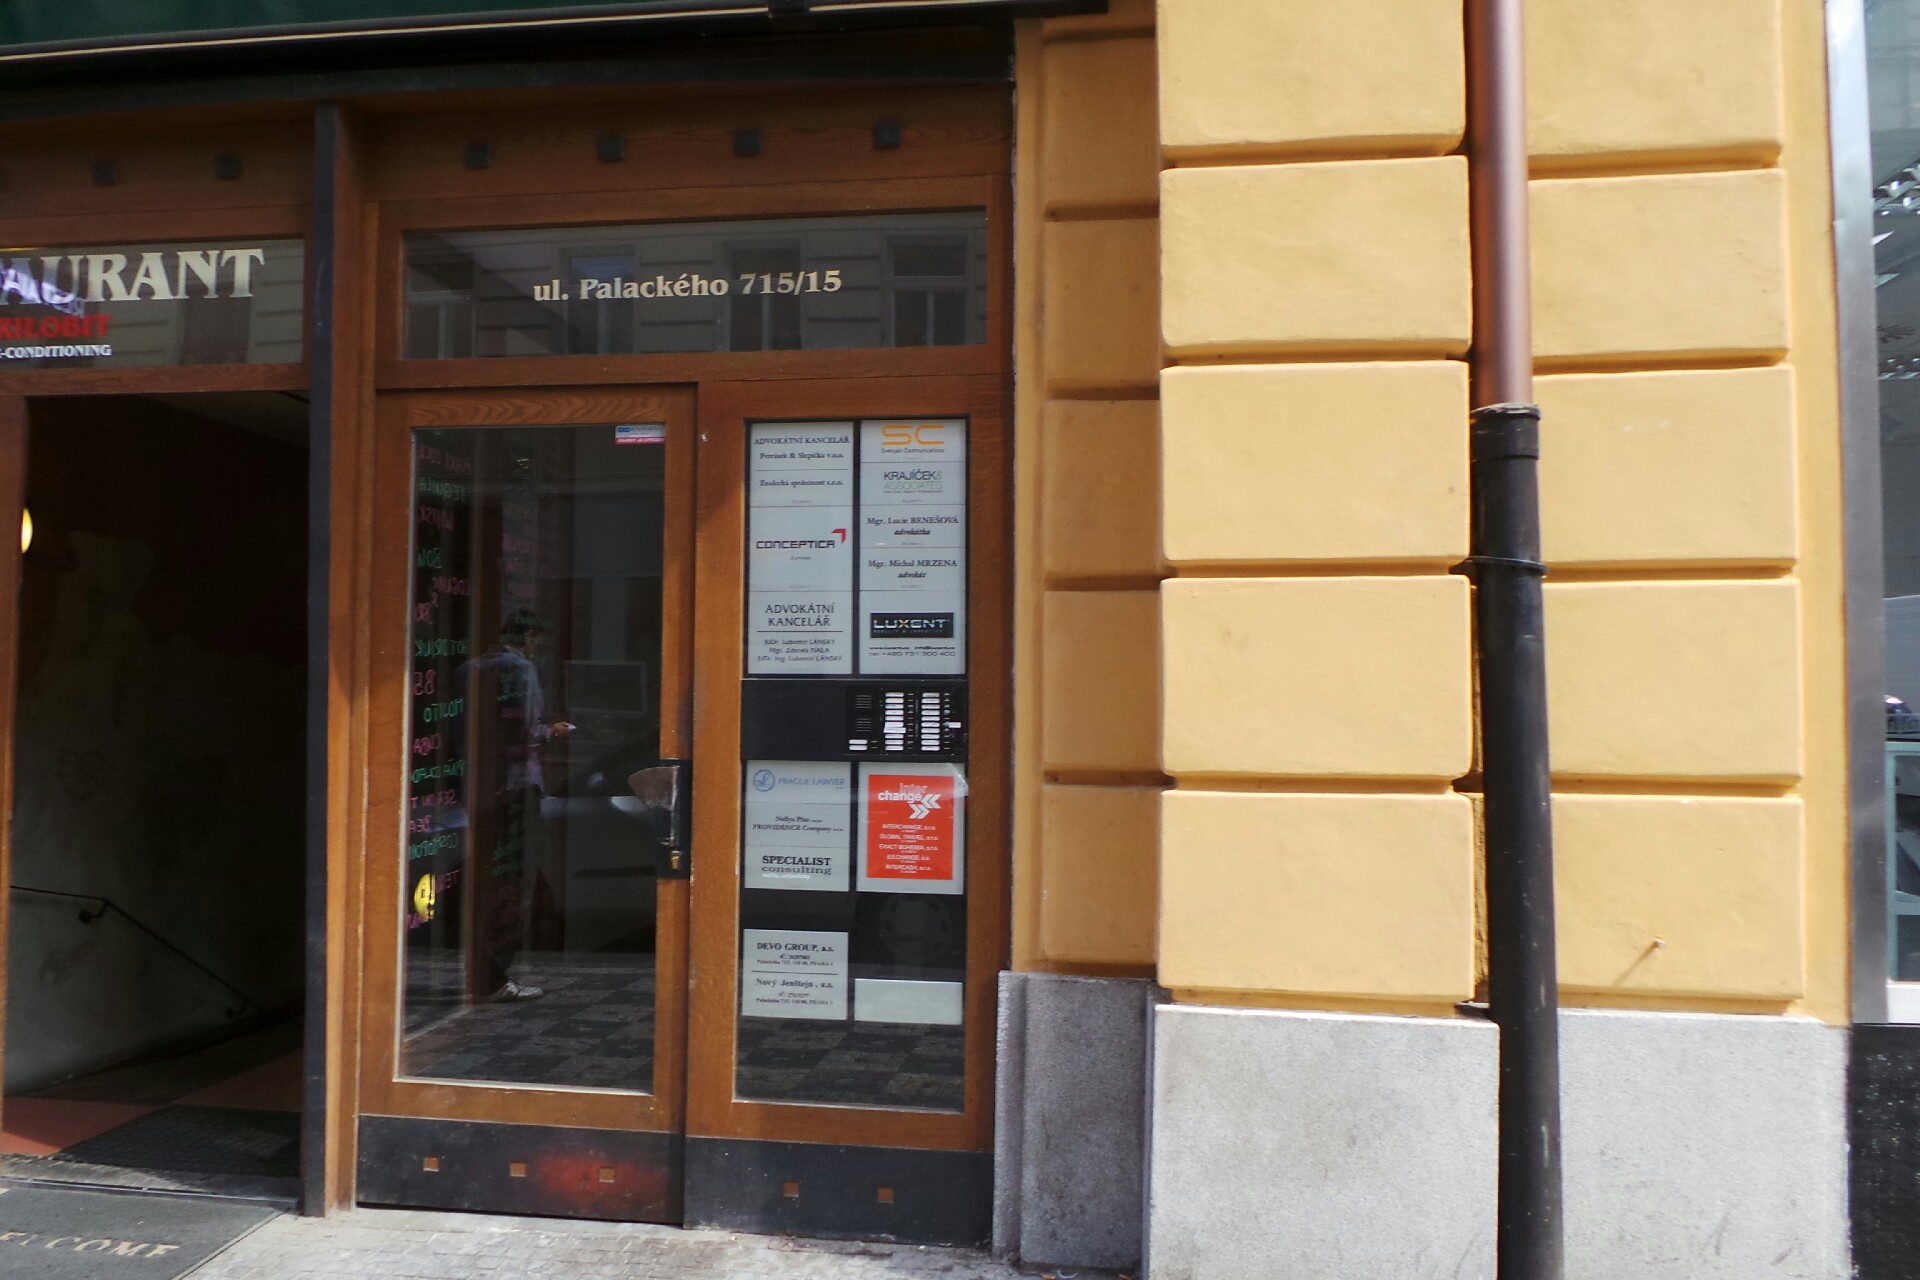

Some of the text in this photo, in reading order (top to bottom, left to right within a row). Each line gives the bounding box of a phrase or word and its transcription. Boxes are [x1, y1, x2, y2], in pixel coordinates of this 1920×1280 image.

[534, 270, 842, 301] ul. Palackého 715/15
[0, 345, 112, 358] -CONDITIONING
[882, 424, 944, 445] SC
[867, 517, 886, 527] Mgr.
[756, 540, 836, 550] CONCEPTICA
[868, 559, 887, 570] Mgr.
[889, 559, 915, 567] Michal
[765, 602, 836, 614] ADVOKÁTNÍ
[768, 615, 831, 627] KANCELÁŘ
[873, 619, 949, 629] LUXENT
[878, 790, 923, 804] change
[762, 855, 831, 866] SPECIALIST
[761, 866, 832, 876] consulting
[756, 942, 782, 951] DEVO
